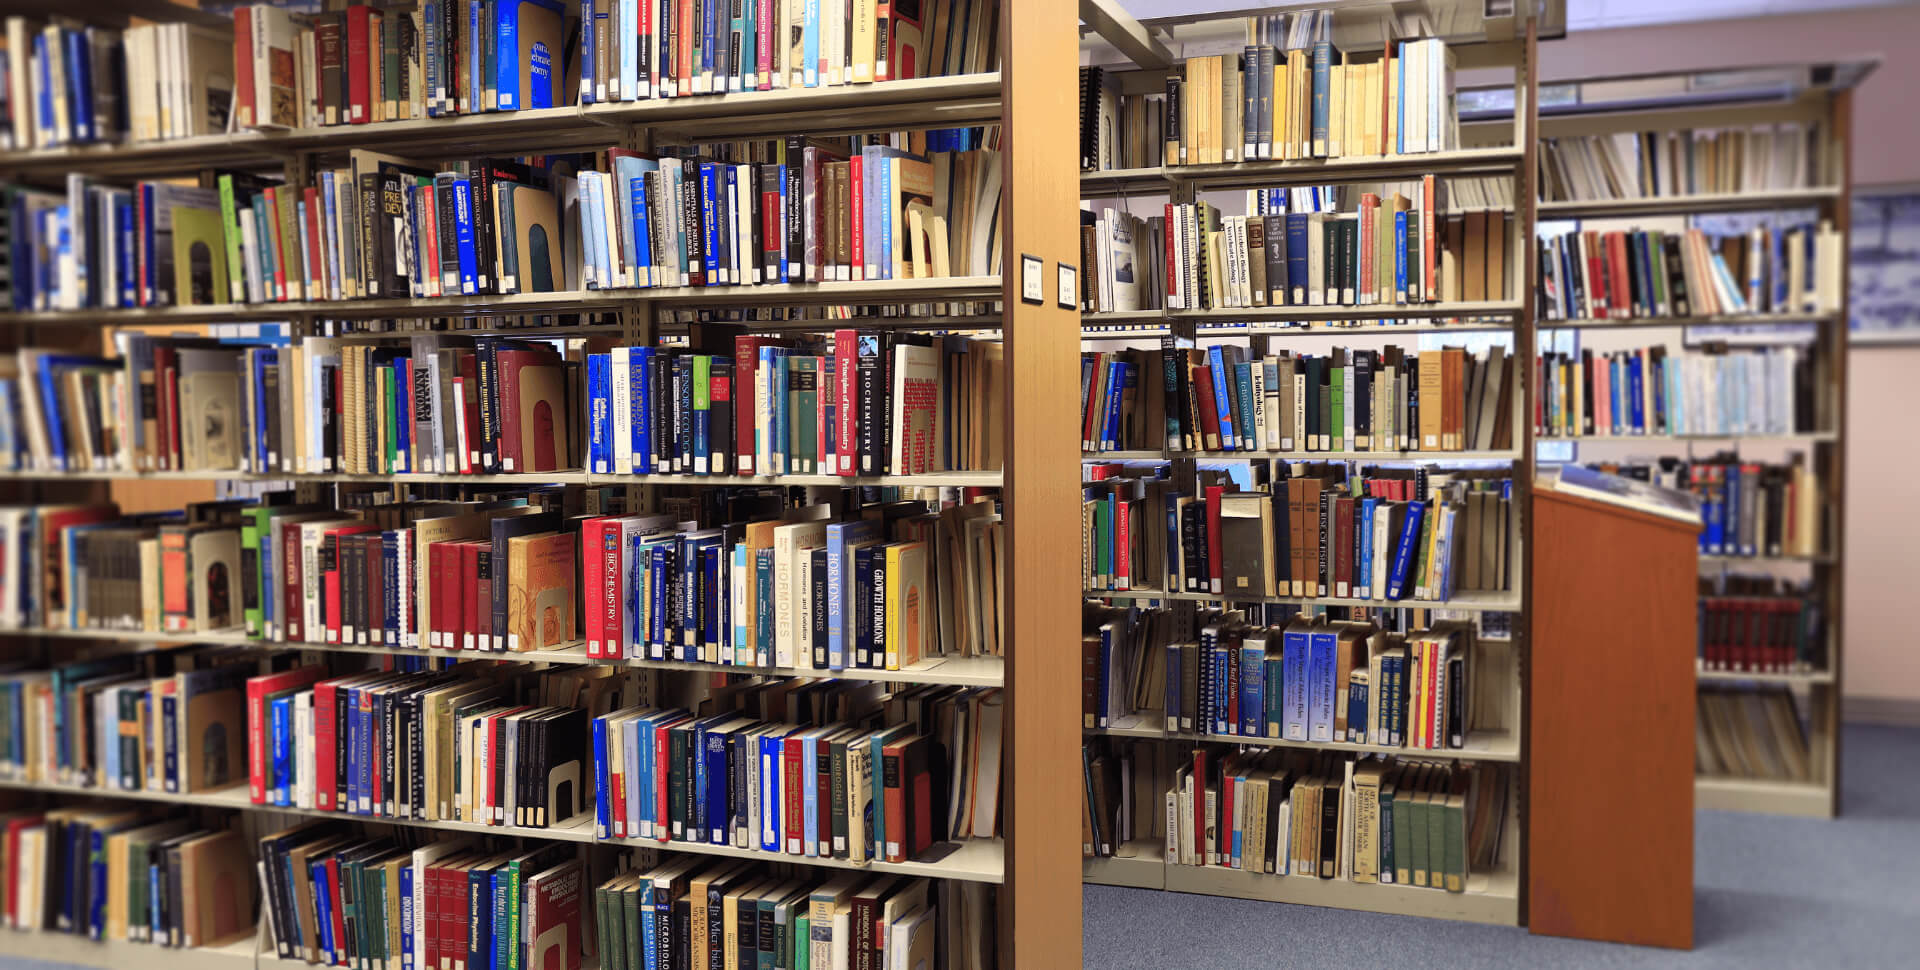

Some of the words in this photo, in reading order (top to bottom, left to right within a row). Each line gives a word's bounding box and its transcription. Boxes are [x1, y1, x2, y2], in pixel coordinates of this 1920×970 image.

[473, 186, 481, 227] EMBRYOLOGY
[689, 181, 697, 217] ESSENTIALS
[793, 178, 801, 232] Neuroendocrinology
[704, 211, 712, 256] Neurobiology
[1226, 225, 1235, 258] Vertebrate
[1237, 225, 1246, 258] Vertebrate
[1239, 260, 1247, 284] Biology
[416, 370, 425, 419] ANATOMY
[682, 369, 690, 408] SENSORY
[842, 358, 850, 393] Principles
[636, 364, 644, 437] DEVELOPMENTAL
[864, 370, 872, 452] BIOCHEMISTRY
[1240, 381, 1250, 430] Ichthyology
[1254, 376, 1263, 416] Ichthyology
[682, 411, 690, 454] ECOLOGY
[841, 403, 850, 451] Biochemistry
[1319, 494, 1328, 510] THE
[1319, 512, 1328, 529] RISE
[1319, 531, 1328, 542] OF
[1319, 545, 1328, 575] FISHES
[607, 553, 616, 620] BIOCHEMISTRY
[778, 563, 789, 638] HORMONES
[828, 553, 839, 616] HORMONES
[873, 569, 884, 603] GROWTH
[816, 581, 824, 632] HORMONES
[873, 605, 884, 645] HORMONE
[385, 713, 393, 749] Incredible
[1323, 704, 1331, 720] Fishes
[498, 886, 507, 917] Vertebrate
[511, 873, 519, 912] Vertebrate
[471, 917, 479, 953] Physiology
[862, 906, 870, 938] HANDBOOK
[511, 915, 519, 969] Endocrinology
